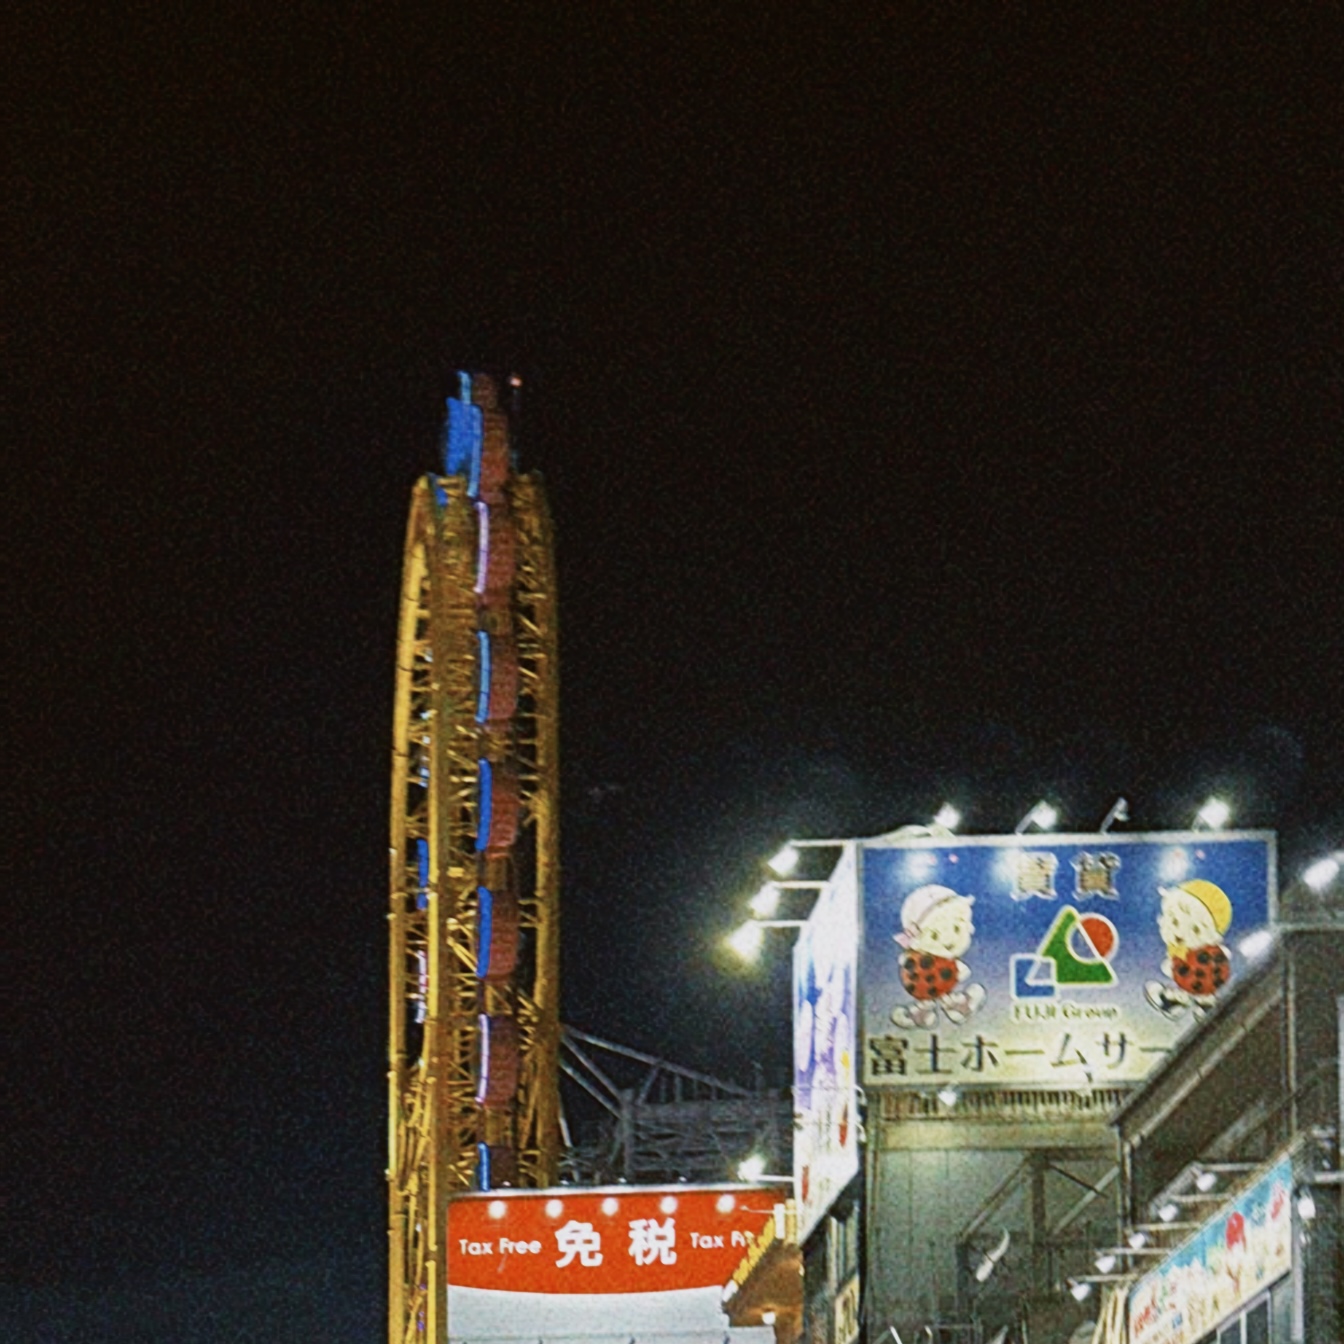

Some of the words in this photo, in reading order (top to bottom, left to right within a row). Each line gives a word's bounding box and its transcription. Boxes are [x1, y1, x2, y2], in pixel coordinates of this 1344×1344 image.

[1061, 1003, 1117, 1020] Group
[459, 1239, 493, 1256] Tax
[499, 1238, 542, 1254] Free
[555, 1217, 677, 1268] 免税
[689, 1231, 724, 1249] Tax
